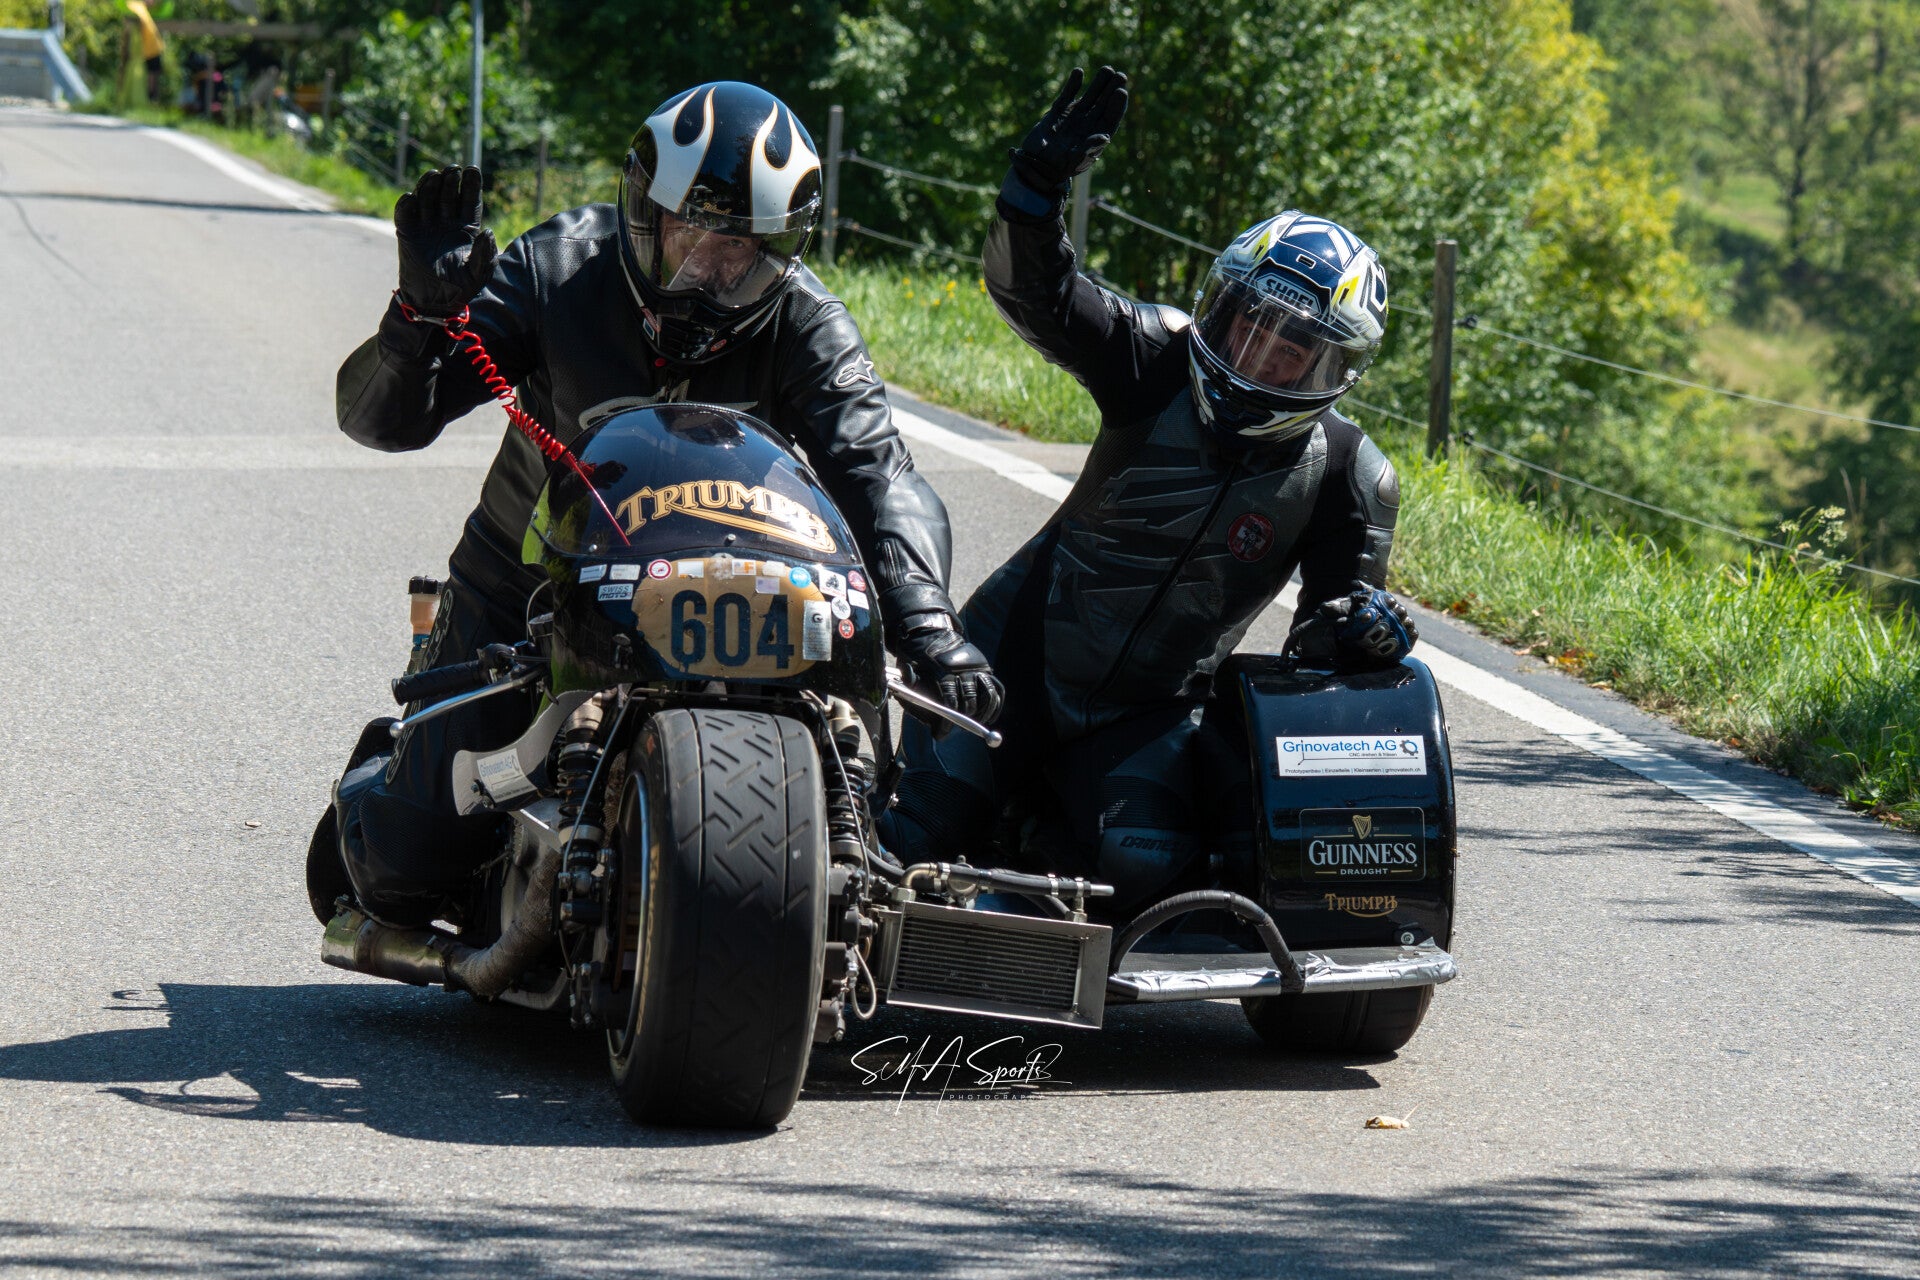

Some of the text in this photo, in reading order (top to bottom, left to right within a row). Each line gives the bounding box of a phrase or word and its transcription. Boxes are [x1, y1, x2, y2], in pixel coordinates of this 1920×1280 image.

[616, 480, 837, 553] TRIUMPH
[671, 590, 795, 670] 604
[1283, 739, 1398, 753] Grinovatech AG
[1308, 840, 1418, 867] GUINNESS
[1340, 867, 1389, 876] DRAUGHT
[1324, 893, 1399, 918] TRIUMPH
